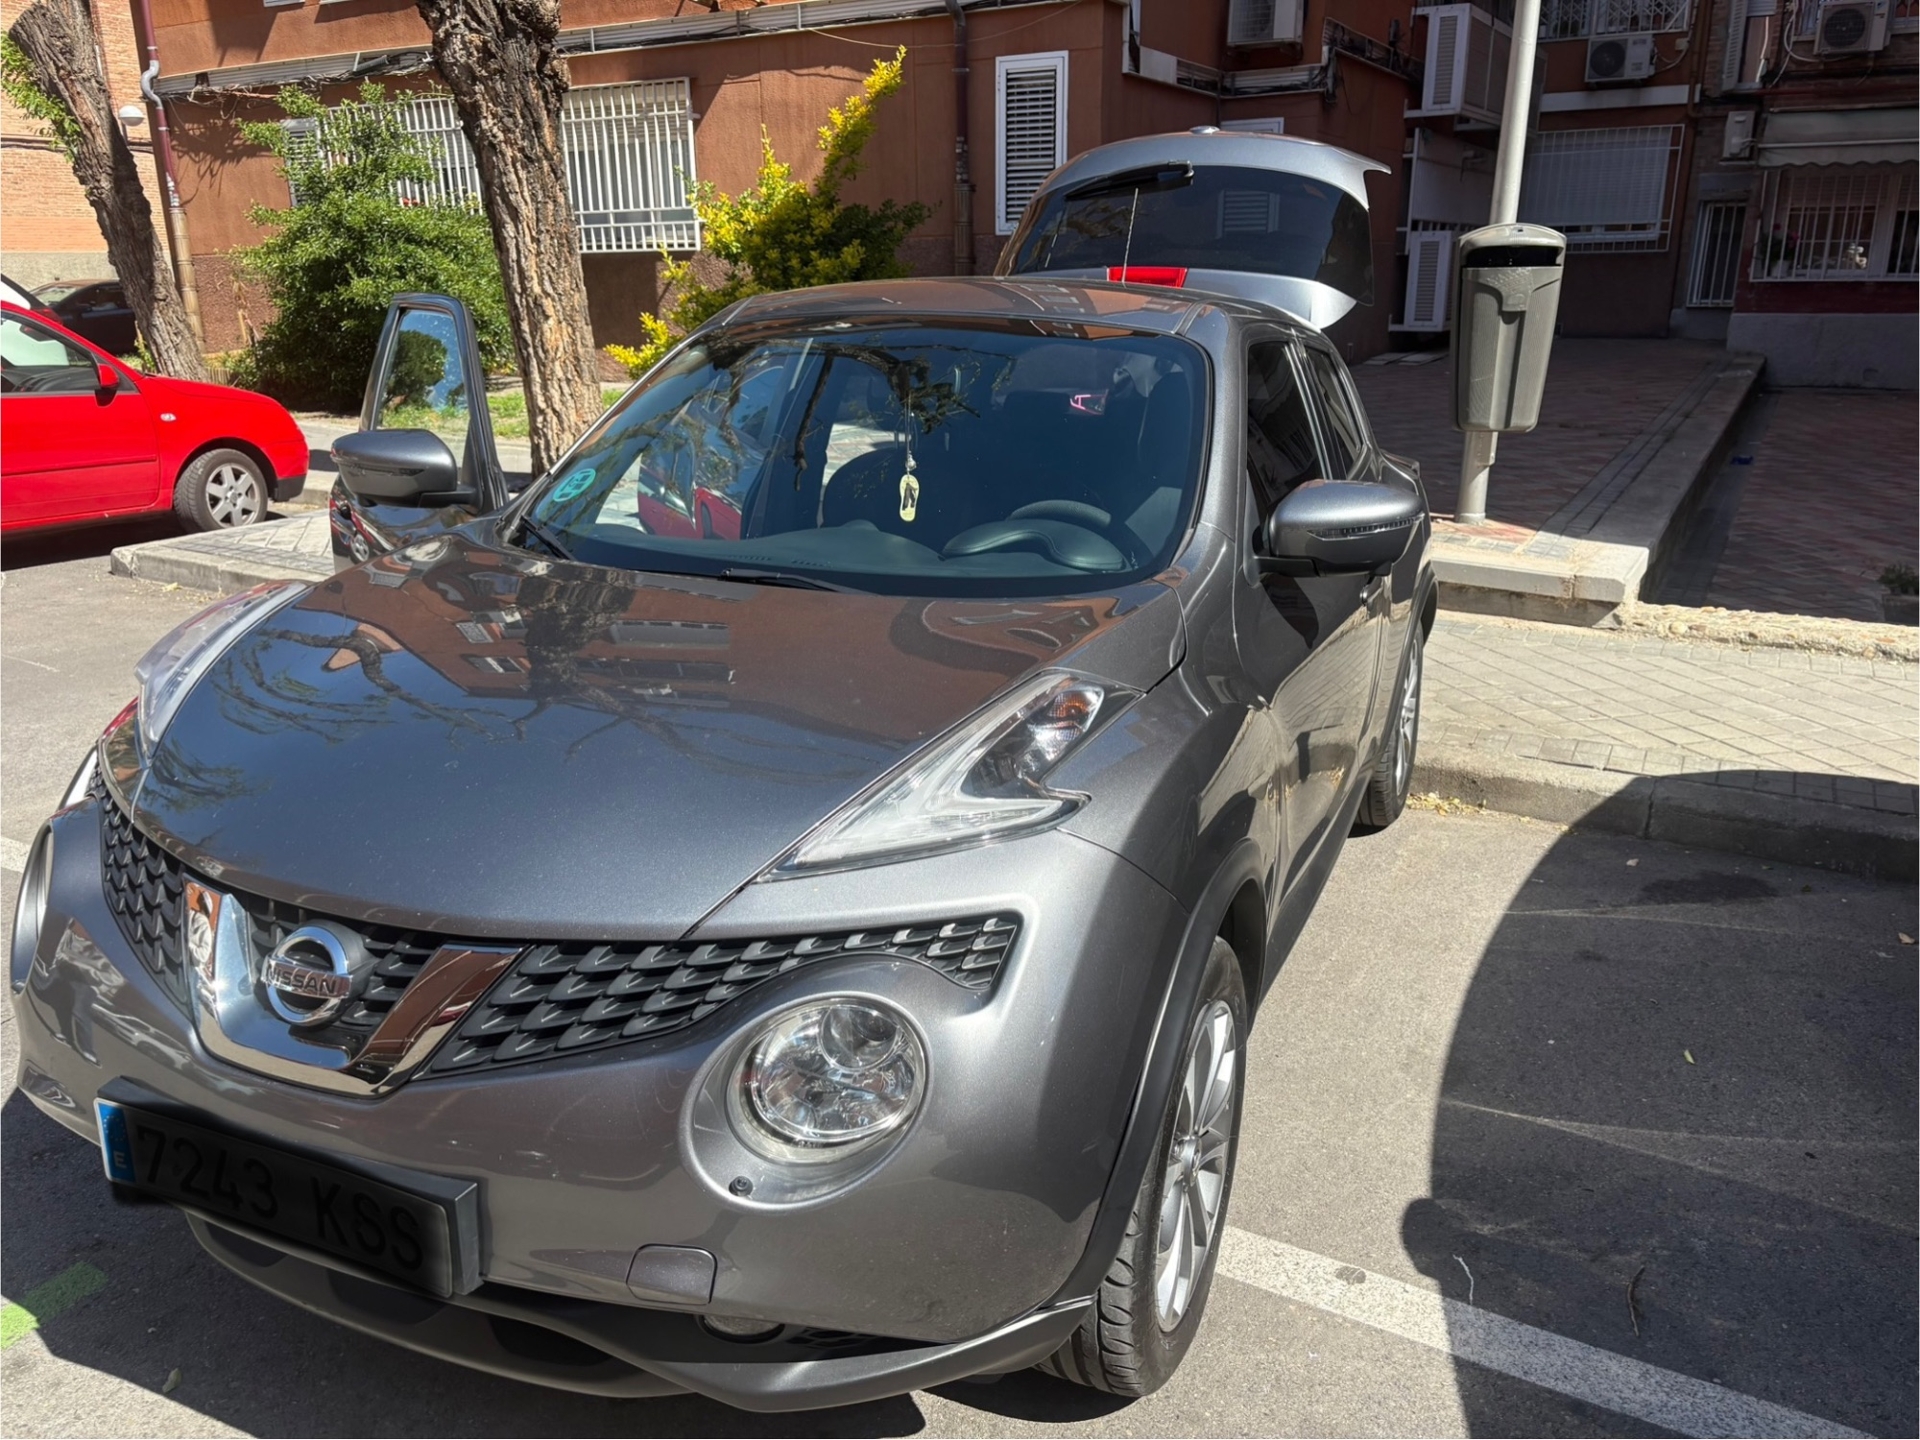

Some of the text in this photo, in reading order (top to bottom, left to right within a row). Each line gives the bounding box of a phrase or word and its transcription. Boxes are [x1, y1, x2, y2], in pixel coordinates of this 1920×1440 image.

[265, 963, 338, 994] NISSAN
[113, 1151, 128, 1169] E
[136, 1124, 423, 1271] 7243 KSS
